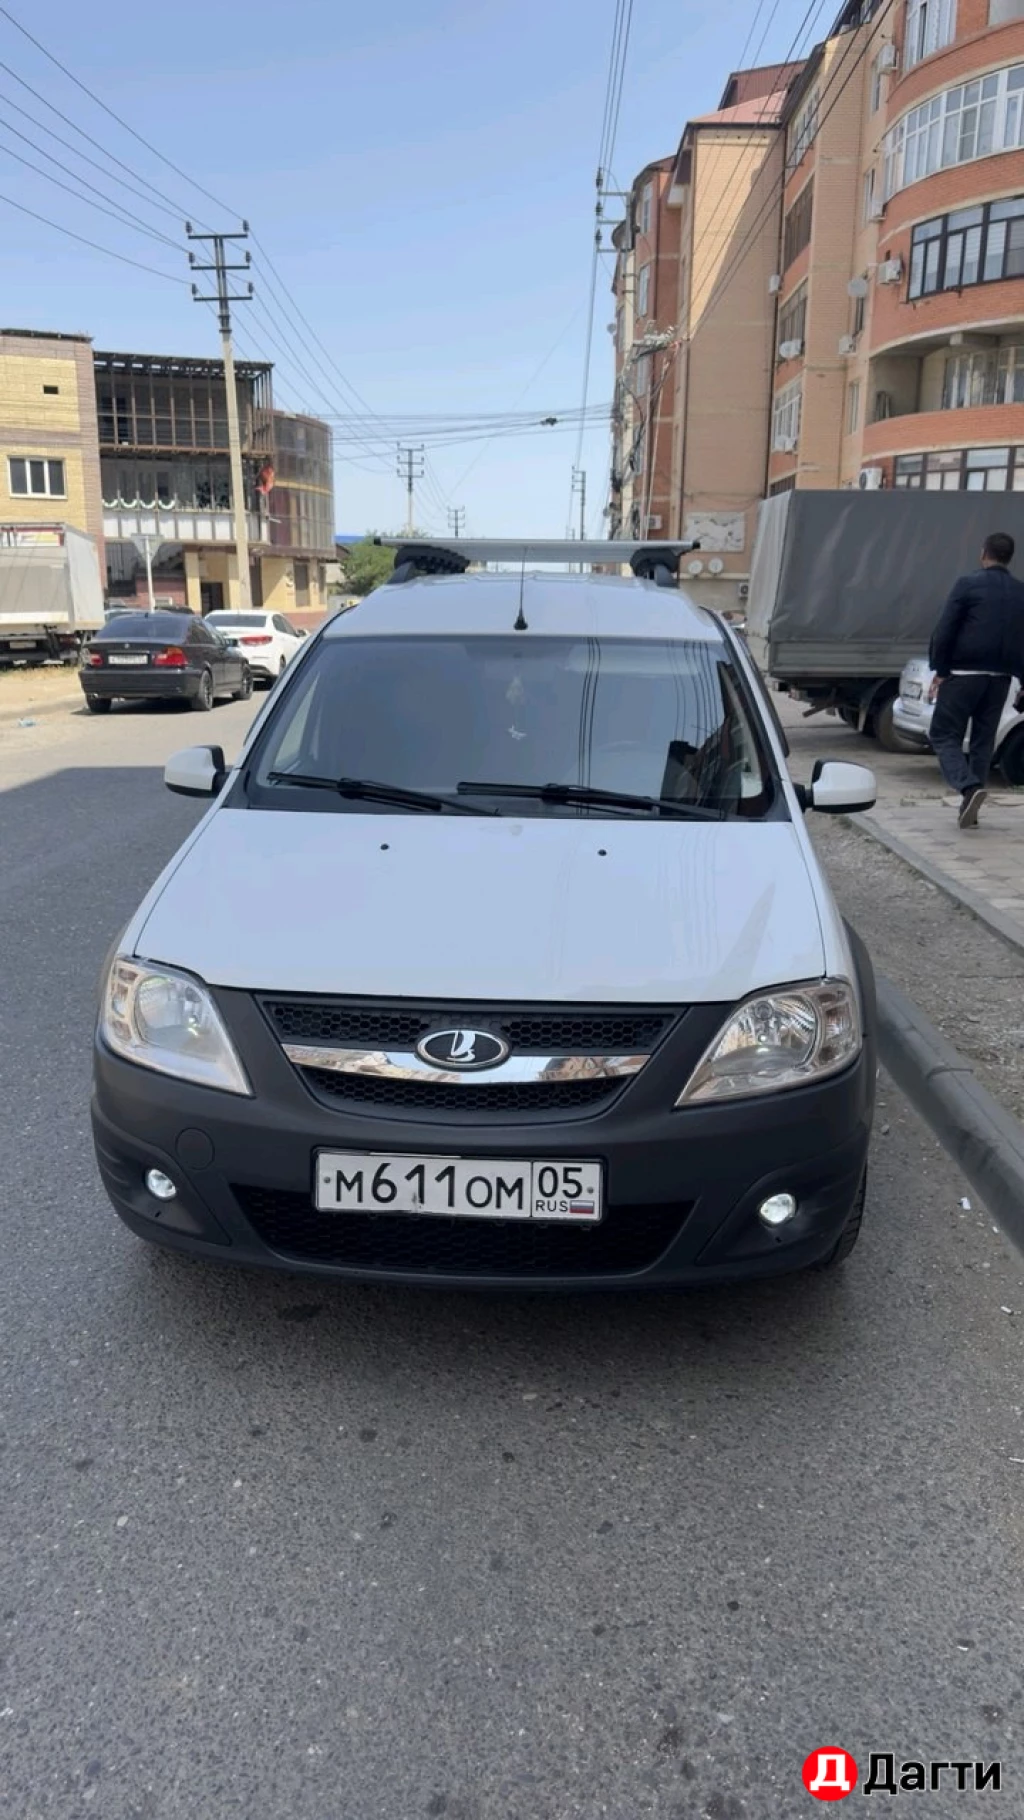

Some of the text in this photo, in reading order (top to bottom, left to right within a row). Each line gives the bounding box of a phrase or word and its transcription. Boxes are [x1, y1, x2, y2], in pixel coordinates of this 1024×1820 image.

[335, 1162, 583, 1211] М611ОМ 05
[535, 1200, 568, 1212] RUS
